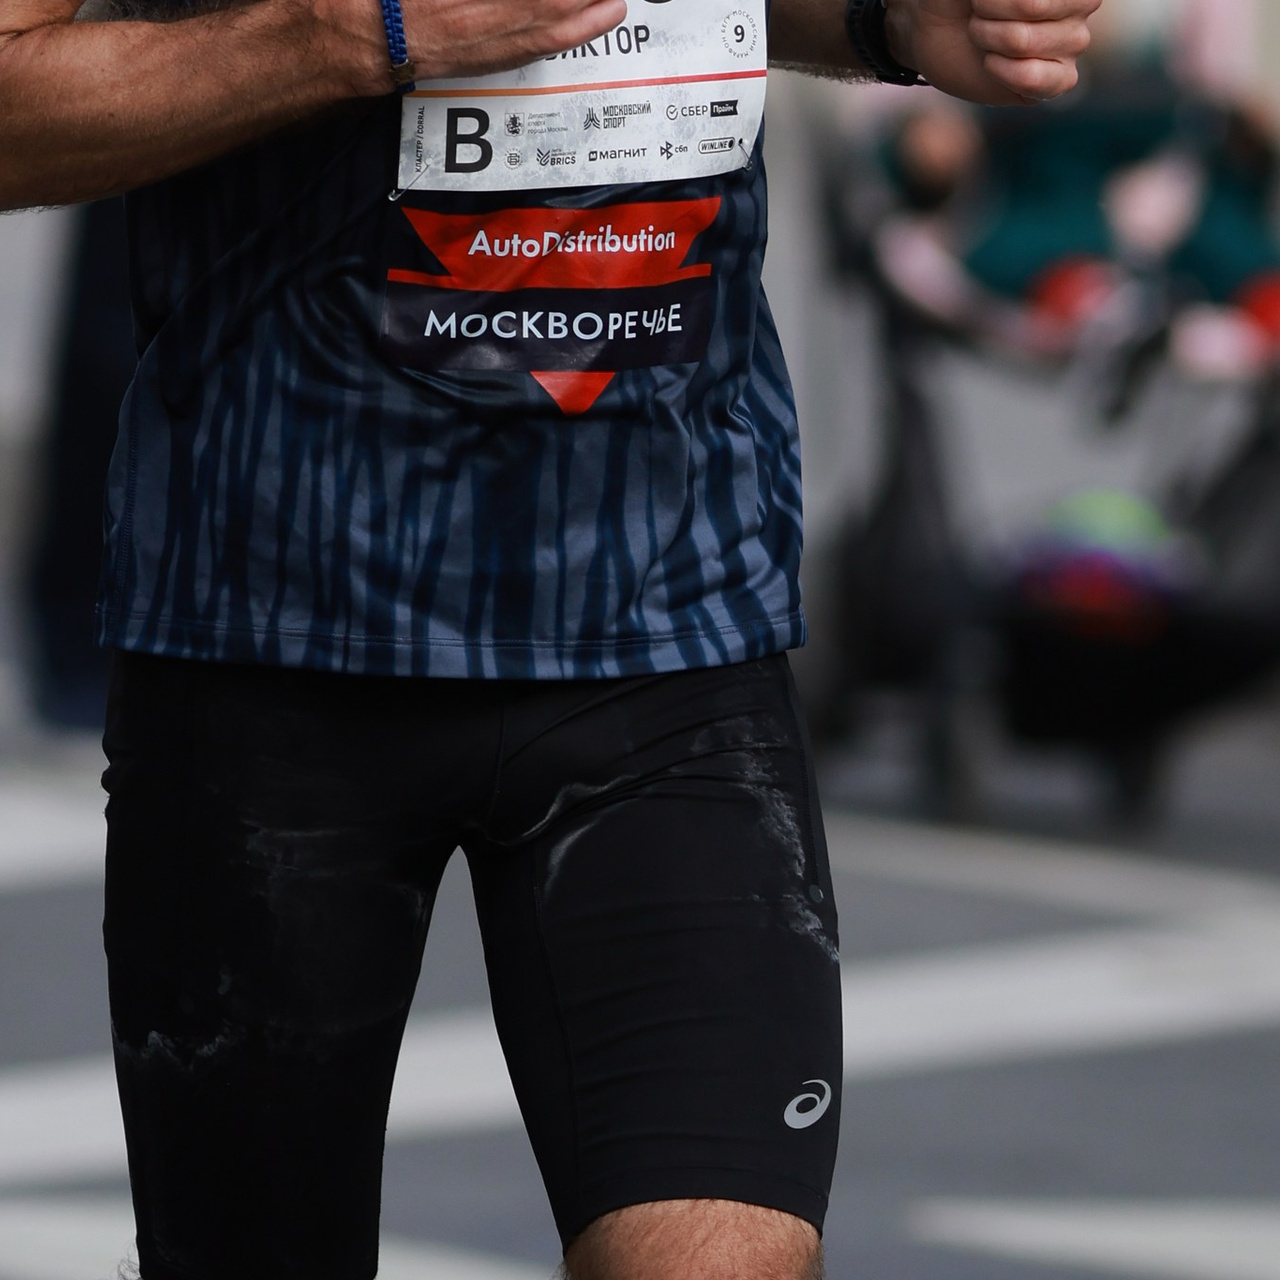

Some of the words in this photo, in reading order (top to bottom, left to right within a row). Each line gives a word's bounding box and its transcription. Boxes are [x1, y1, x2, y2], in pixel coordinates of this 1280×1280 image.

[733, 24, 745, 43] 9
[602, 100, 652, 117] МОСКОВСКИЙ
[681, 105, 708, 117] СБЕР
[417, 106, 425, 135] CORRAL
[603, 116, 626, 129] СПОРТ
[674, 144, 688, 153] сбп
[701, 141, 728, 151] WINLINE
[550, 156, 576, 166] BRICS
[468, 224, 675, 258] AutoDistribution
[424, 304, 683, 340] МОСКВОРЕЧЬЕ
